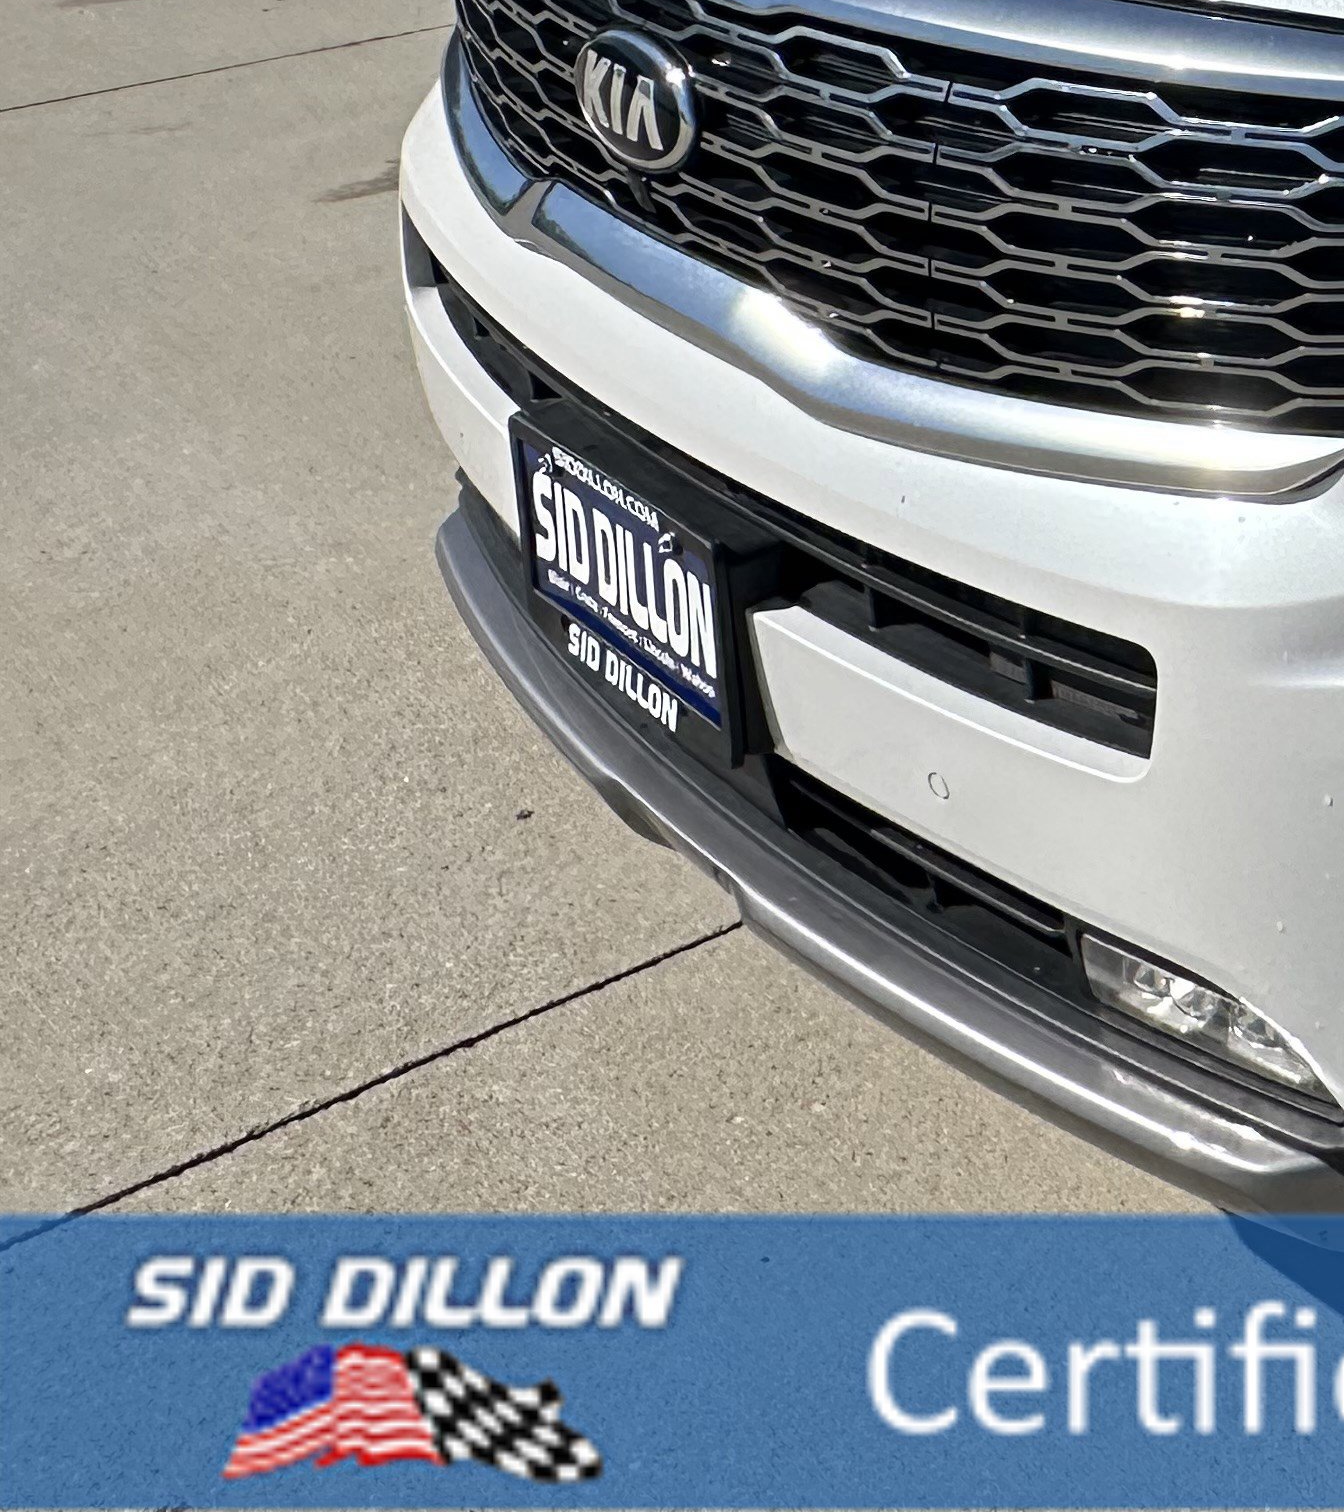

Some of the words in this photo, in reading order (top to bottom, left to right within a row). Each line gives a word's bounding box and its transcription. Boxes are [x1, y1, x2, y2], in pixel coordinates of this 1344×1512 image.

[578, 46, 666, 152] KIA
[532, 471, 590, 585] SID
[591, 506, 718, 679] DILLON
[567, 622, 601, 672] SID
[604, 649, 680, 733] DILLON
